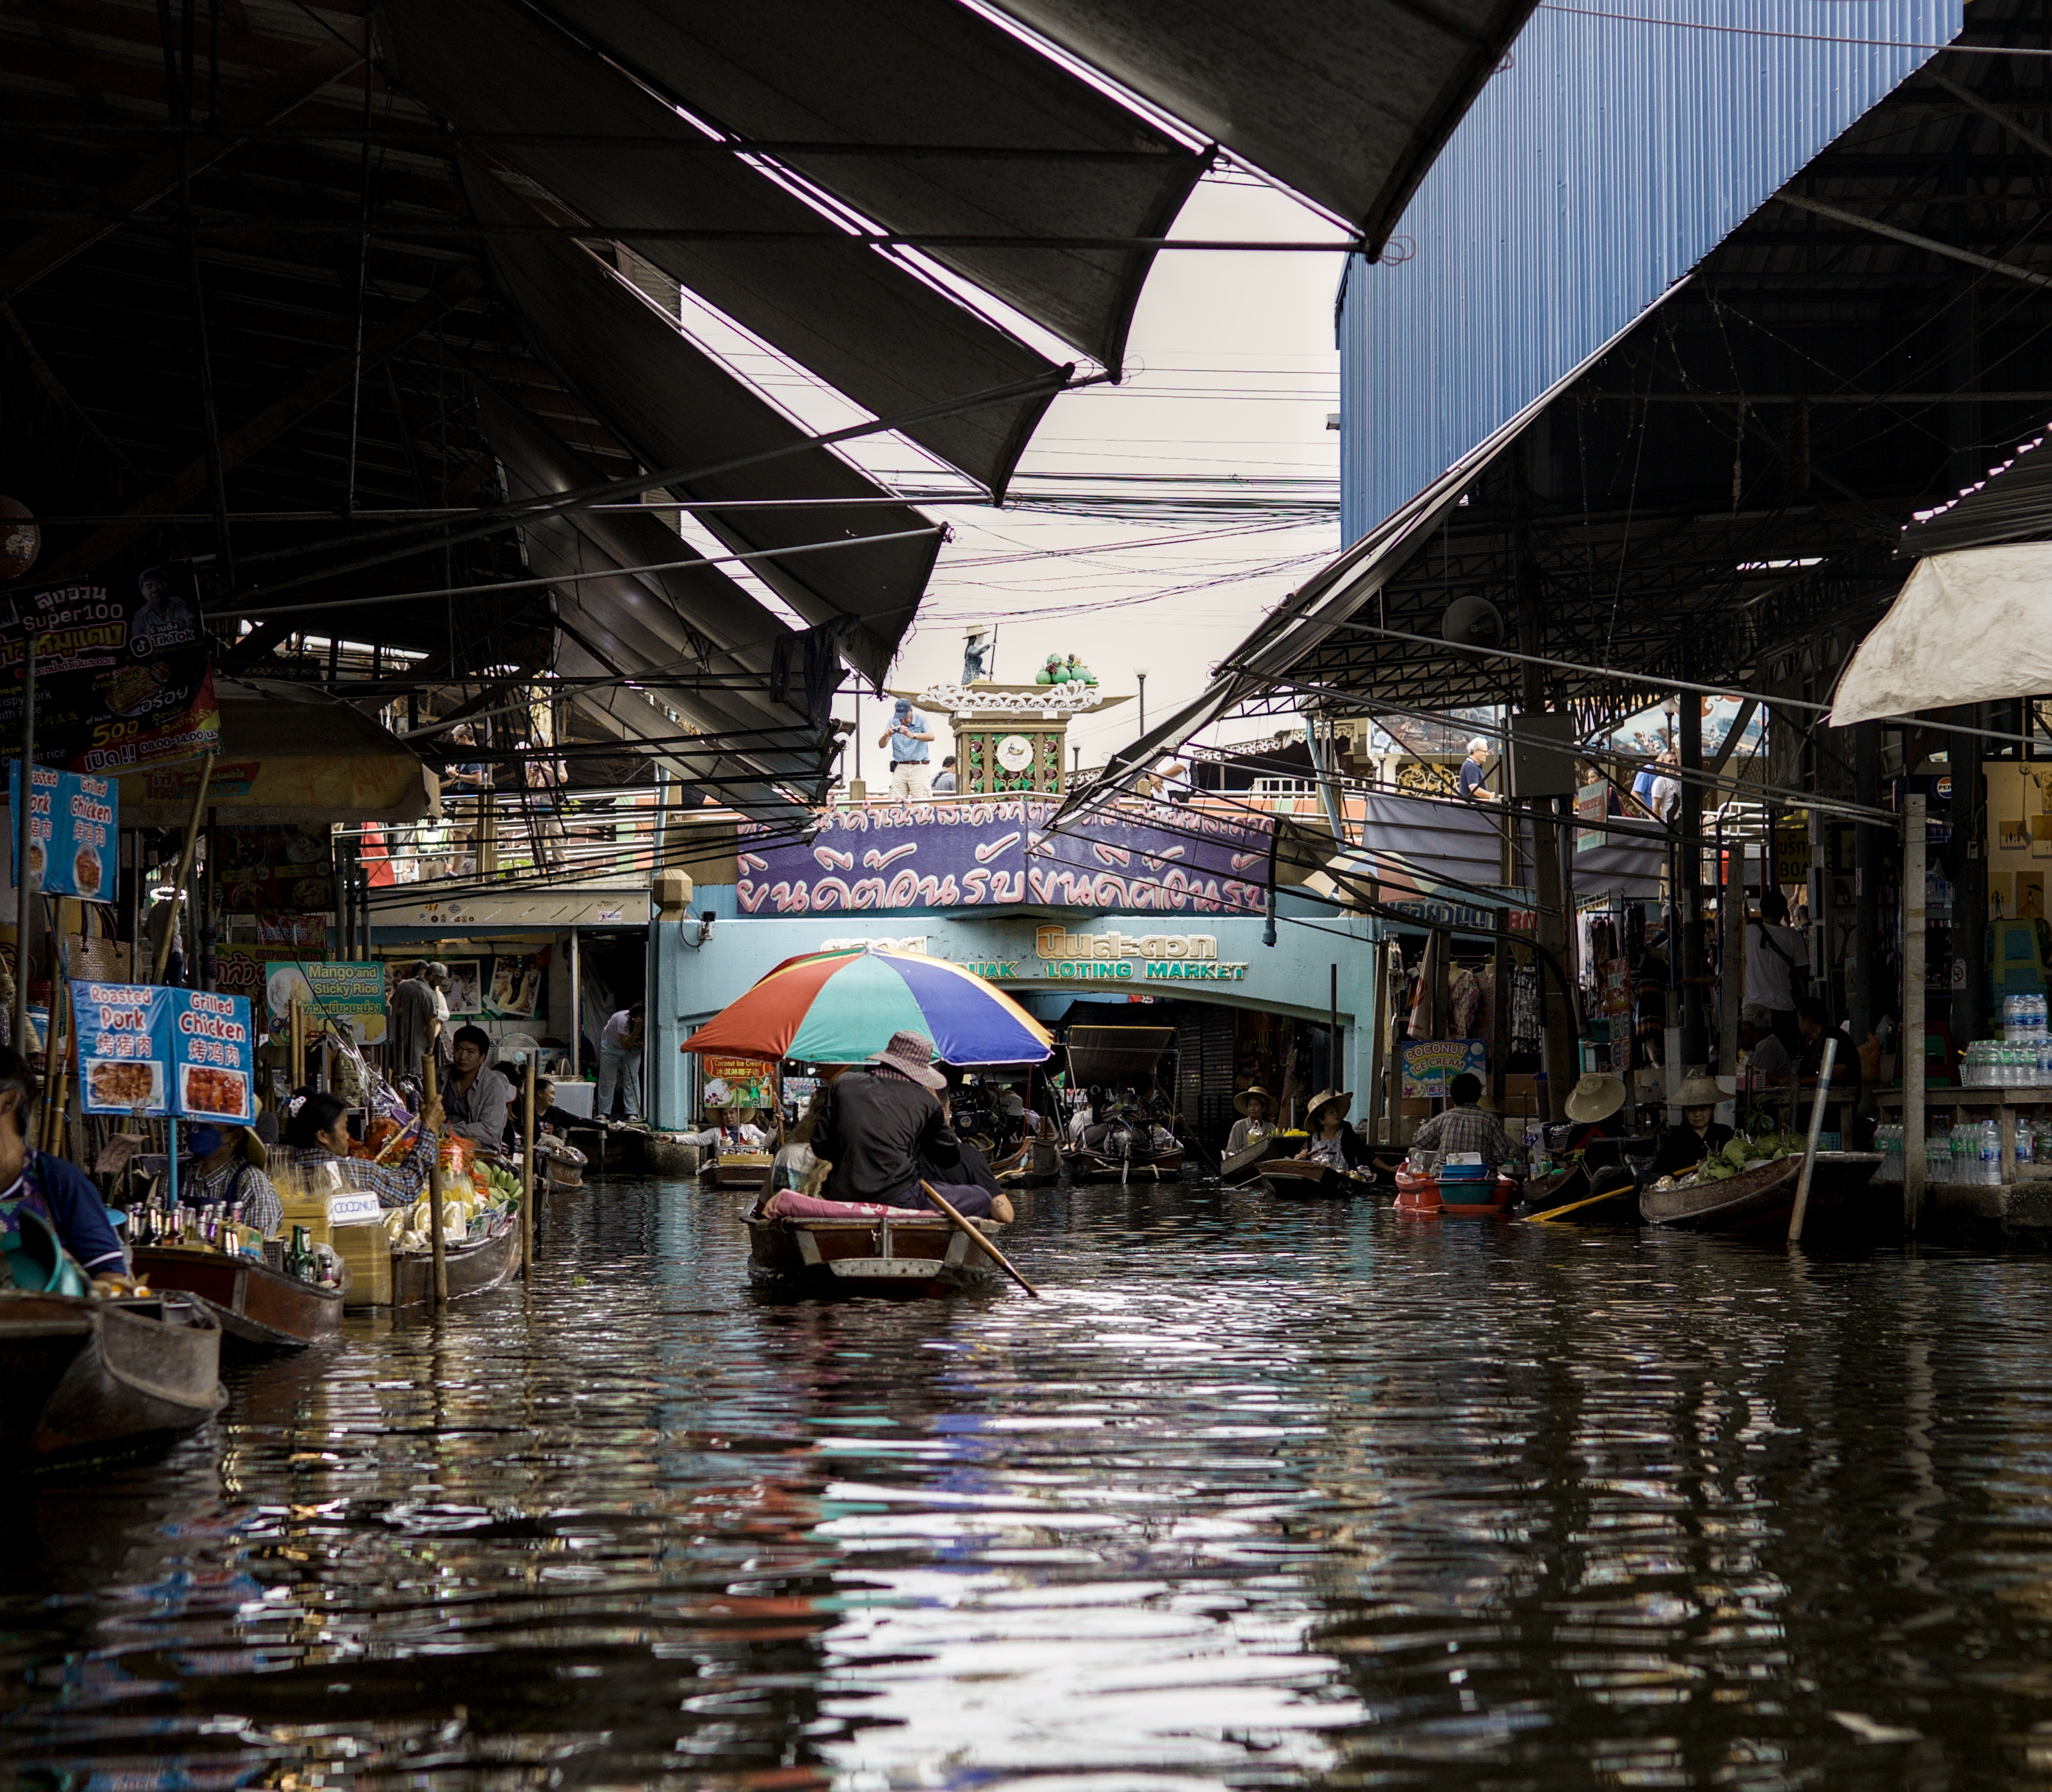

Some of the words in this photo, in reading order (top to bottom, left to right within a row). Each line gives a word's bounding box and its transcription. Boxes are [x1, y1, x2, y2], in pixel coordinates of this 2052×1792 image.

[23, 603, 124, 631] Super100
[152, 629, 195, 647] TikTok
[34, 656, 116, 676] ลาดน้ำดำเนินสะดวก
[119, 671, 140, 683] Pork
[0, 697, 24, 707] rispy
[34, 689, 52, 701] ork
[140, 685, 188, 713] อร่อย
[92, 722, 125, 746] 50
[139, 730, 206, 753] 08.00-14.00
[46, 748, 66, 760] rice
[33, 769, 58, 787] asted
[80, 776, 108, 797] Grilled
[31, 792, 52, 815] ork
[70, 795, 112, 823] Chicken
[308, 965, 355, 982] Mango
[356, 966, 377, 979] and
[1047, 960, 1134, 979] LOTING
[1143, 961, 1249, 980] MARKET
[90, 985, 153, 1004] Roasted
[314, 983, 351, 998] Sticky
[352, 983, 379, 995] Rice
[190, 993, 234, 1016] Grilled
[100, 1006, 146, 1030] Pork
[180, 1011, 246, 1042] Chicken
[96, 1032, 153, 1058] 烤猪肉
[188, 1038, 240, 1068] 烤鸡肉
[1404, 1042, 1468, 1061] COCONUT
[1410, 1061, 1427, 1075] ICE
[1429, 1058, 1465, 1070] CREAM
[334, 1200, 379, 1215] COCONUT
